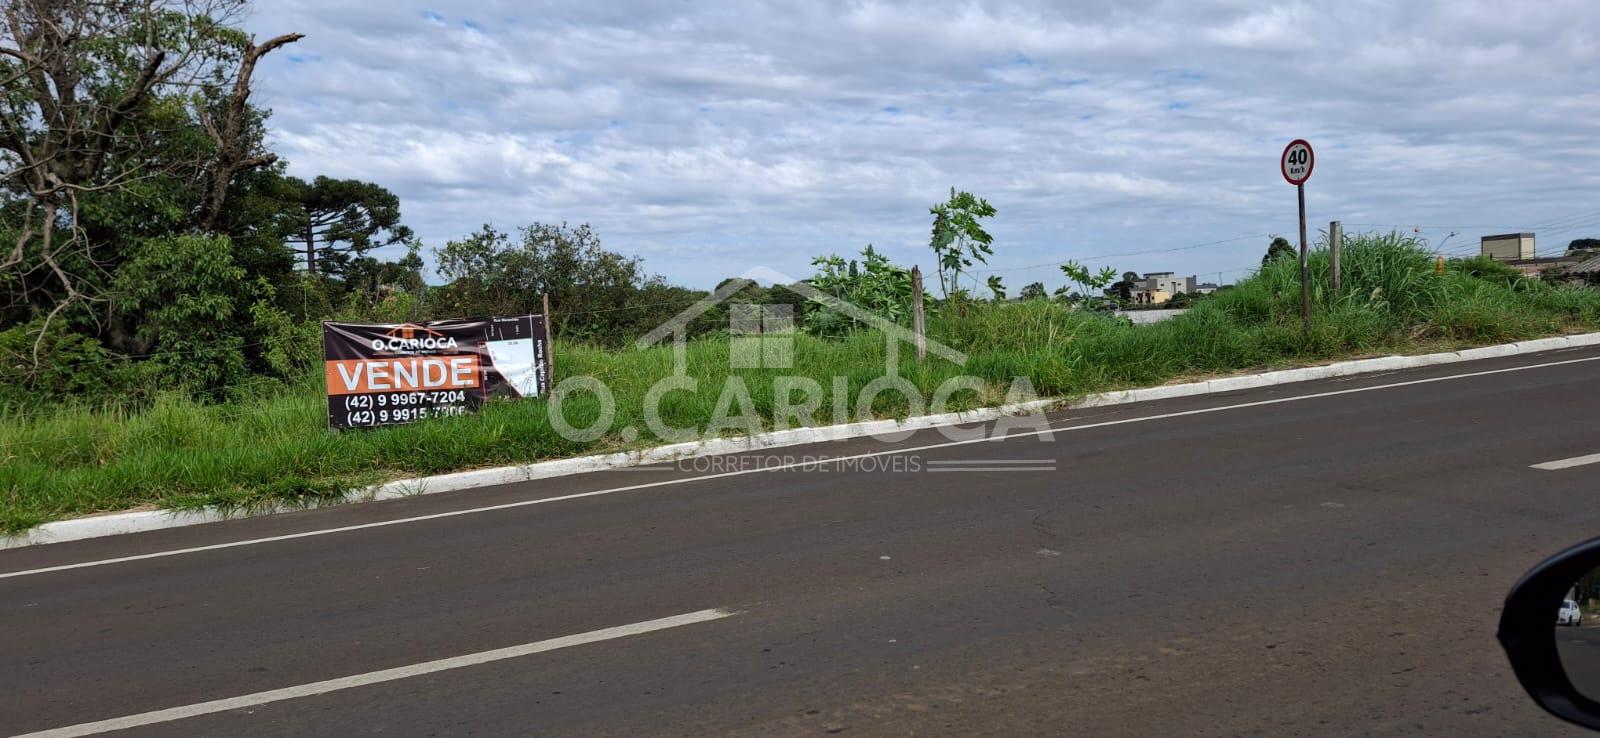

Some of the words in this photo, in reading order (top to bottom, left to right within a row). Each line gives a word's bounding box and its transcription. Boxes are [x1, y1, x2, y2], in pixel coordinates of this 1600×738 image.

[1288, 149, 1307, 165] 40
[372, 337, 458, 351] O.CARIOCA
[336, 358, 474, 391] VENDE
[345, 395, 373, 411] (42)
[378, 394, 387, 406] 9
[391, 390, 465, 405] 9967-7204
[347, 410, 375, 426] (42)
[380, 410, 388, 422] 9
